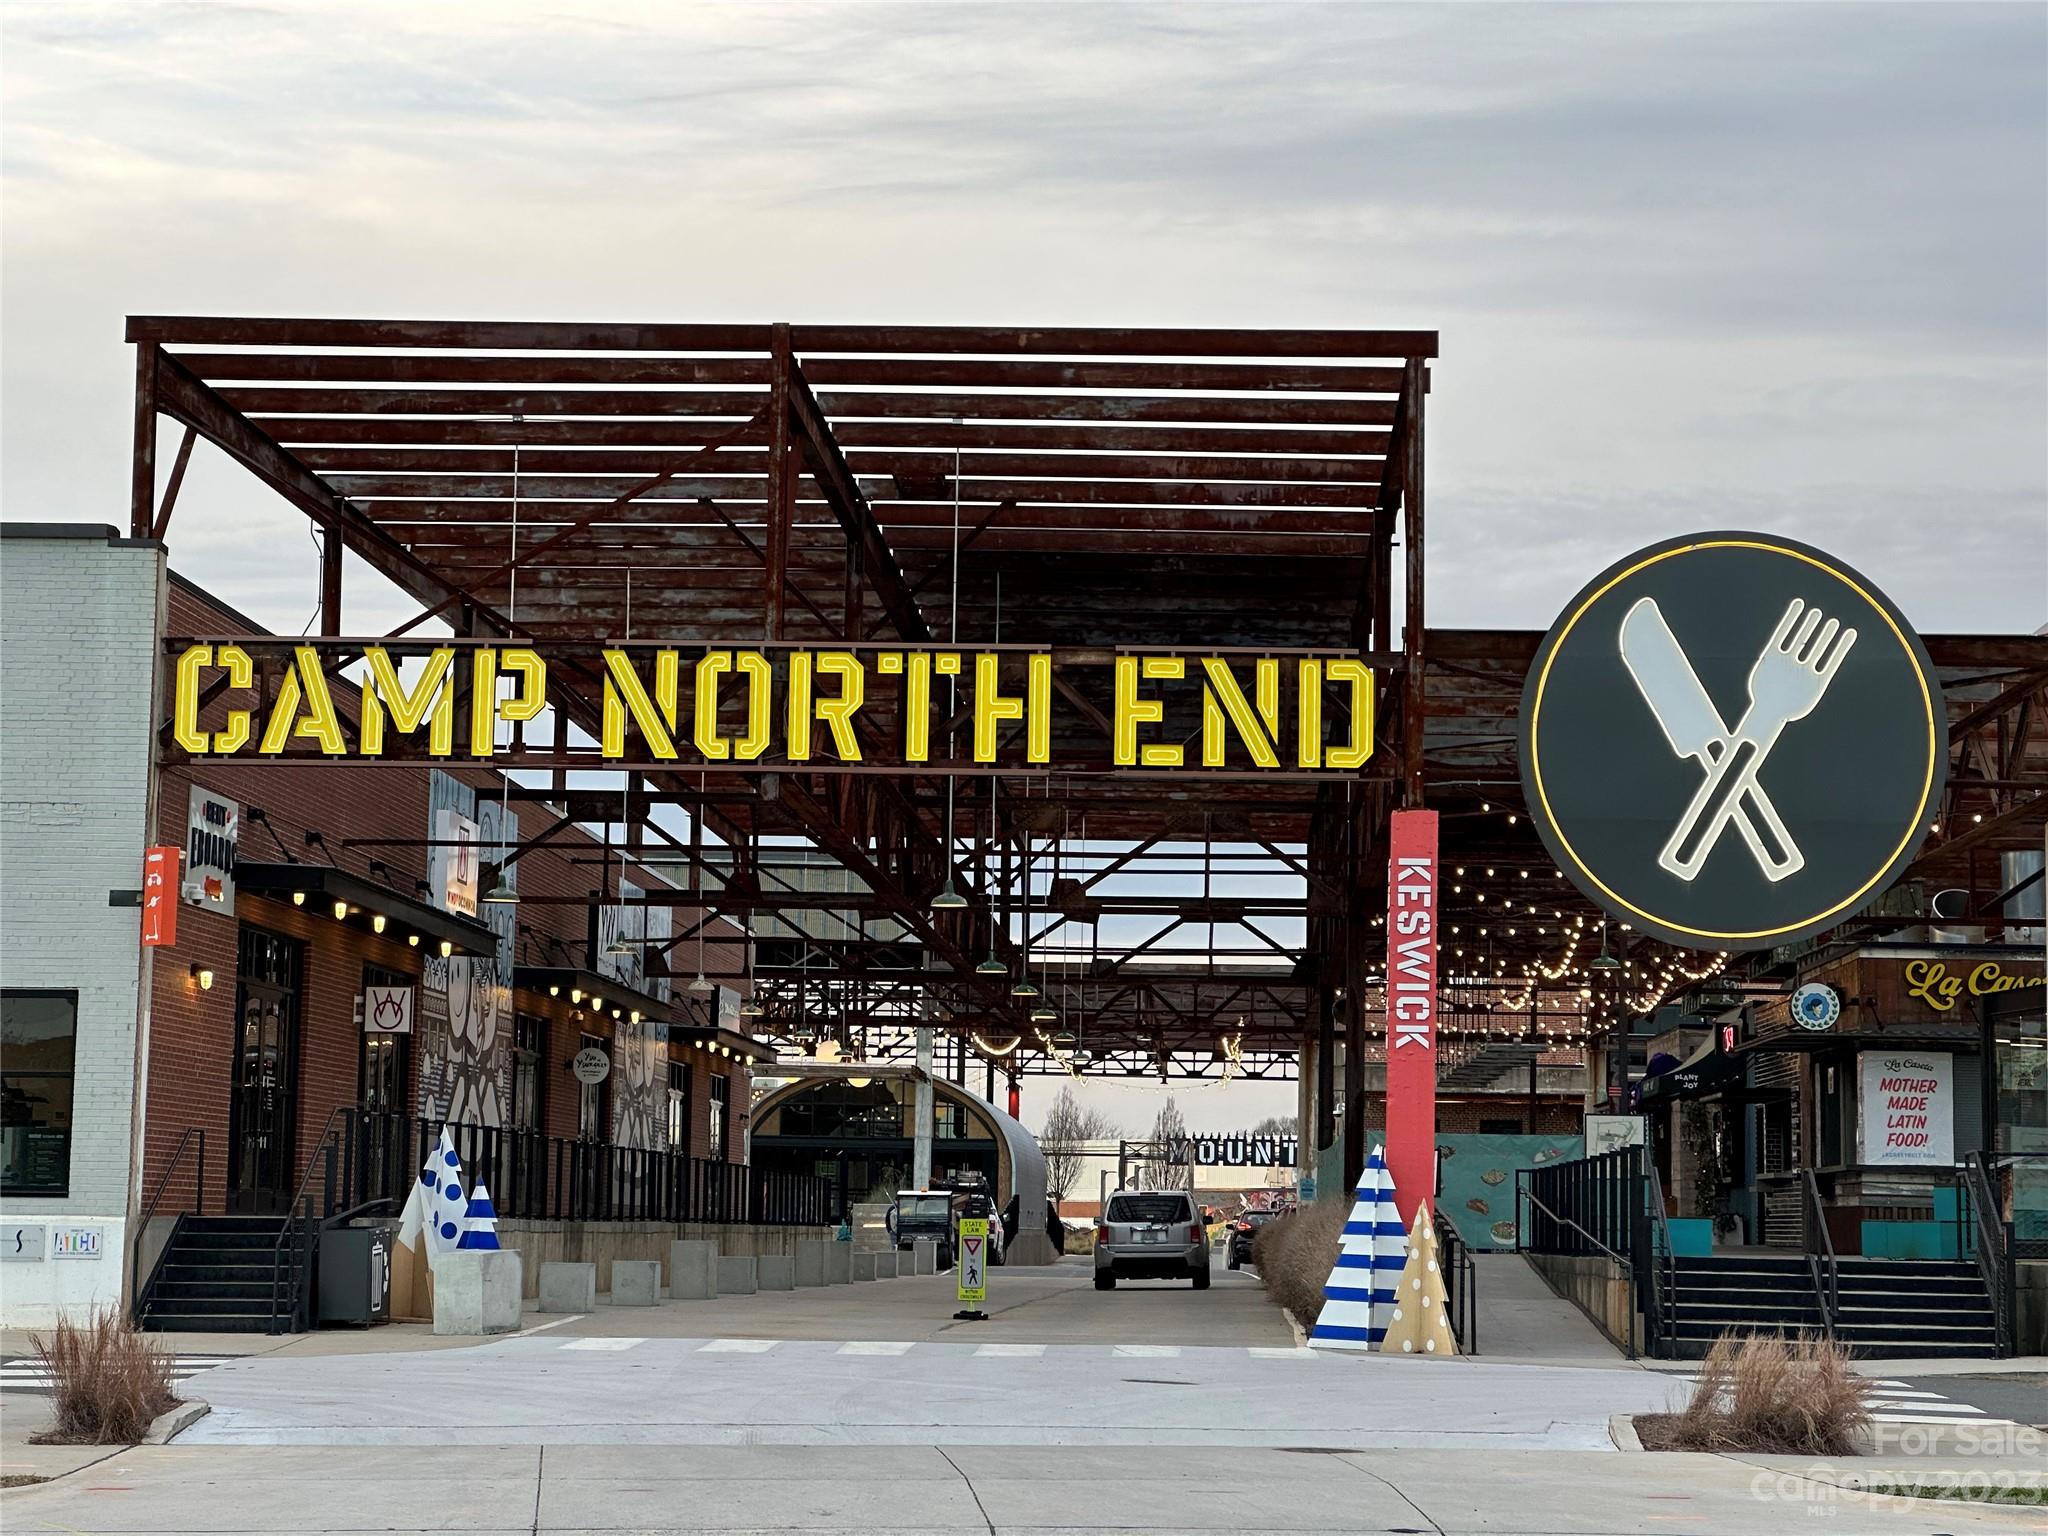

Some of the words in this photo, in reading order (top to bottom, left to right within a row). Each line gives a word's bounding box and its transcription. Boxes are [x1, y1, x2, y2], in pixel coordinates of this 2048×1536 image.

[173, 644, 547, 758] CAMP
[602, 649, 1052, 763] NORTH
[1113, 655, 1375, 768] END
[1395, 857, 1432, 1049] KESWICK
[1905, 960, 1963, 1011] La
[1884, 1060, 1901, 1073] La
[1674, 1073, 1699, 1082] PLANT
[1880, 1077, 1938, 1094] MOTHER
[1887, 1096, 1928, 1111] MADE
[1887, 1114, 1927, 1129] LATIN
[1887, 1133, 1928, 1147] FOOD!
